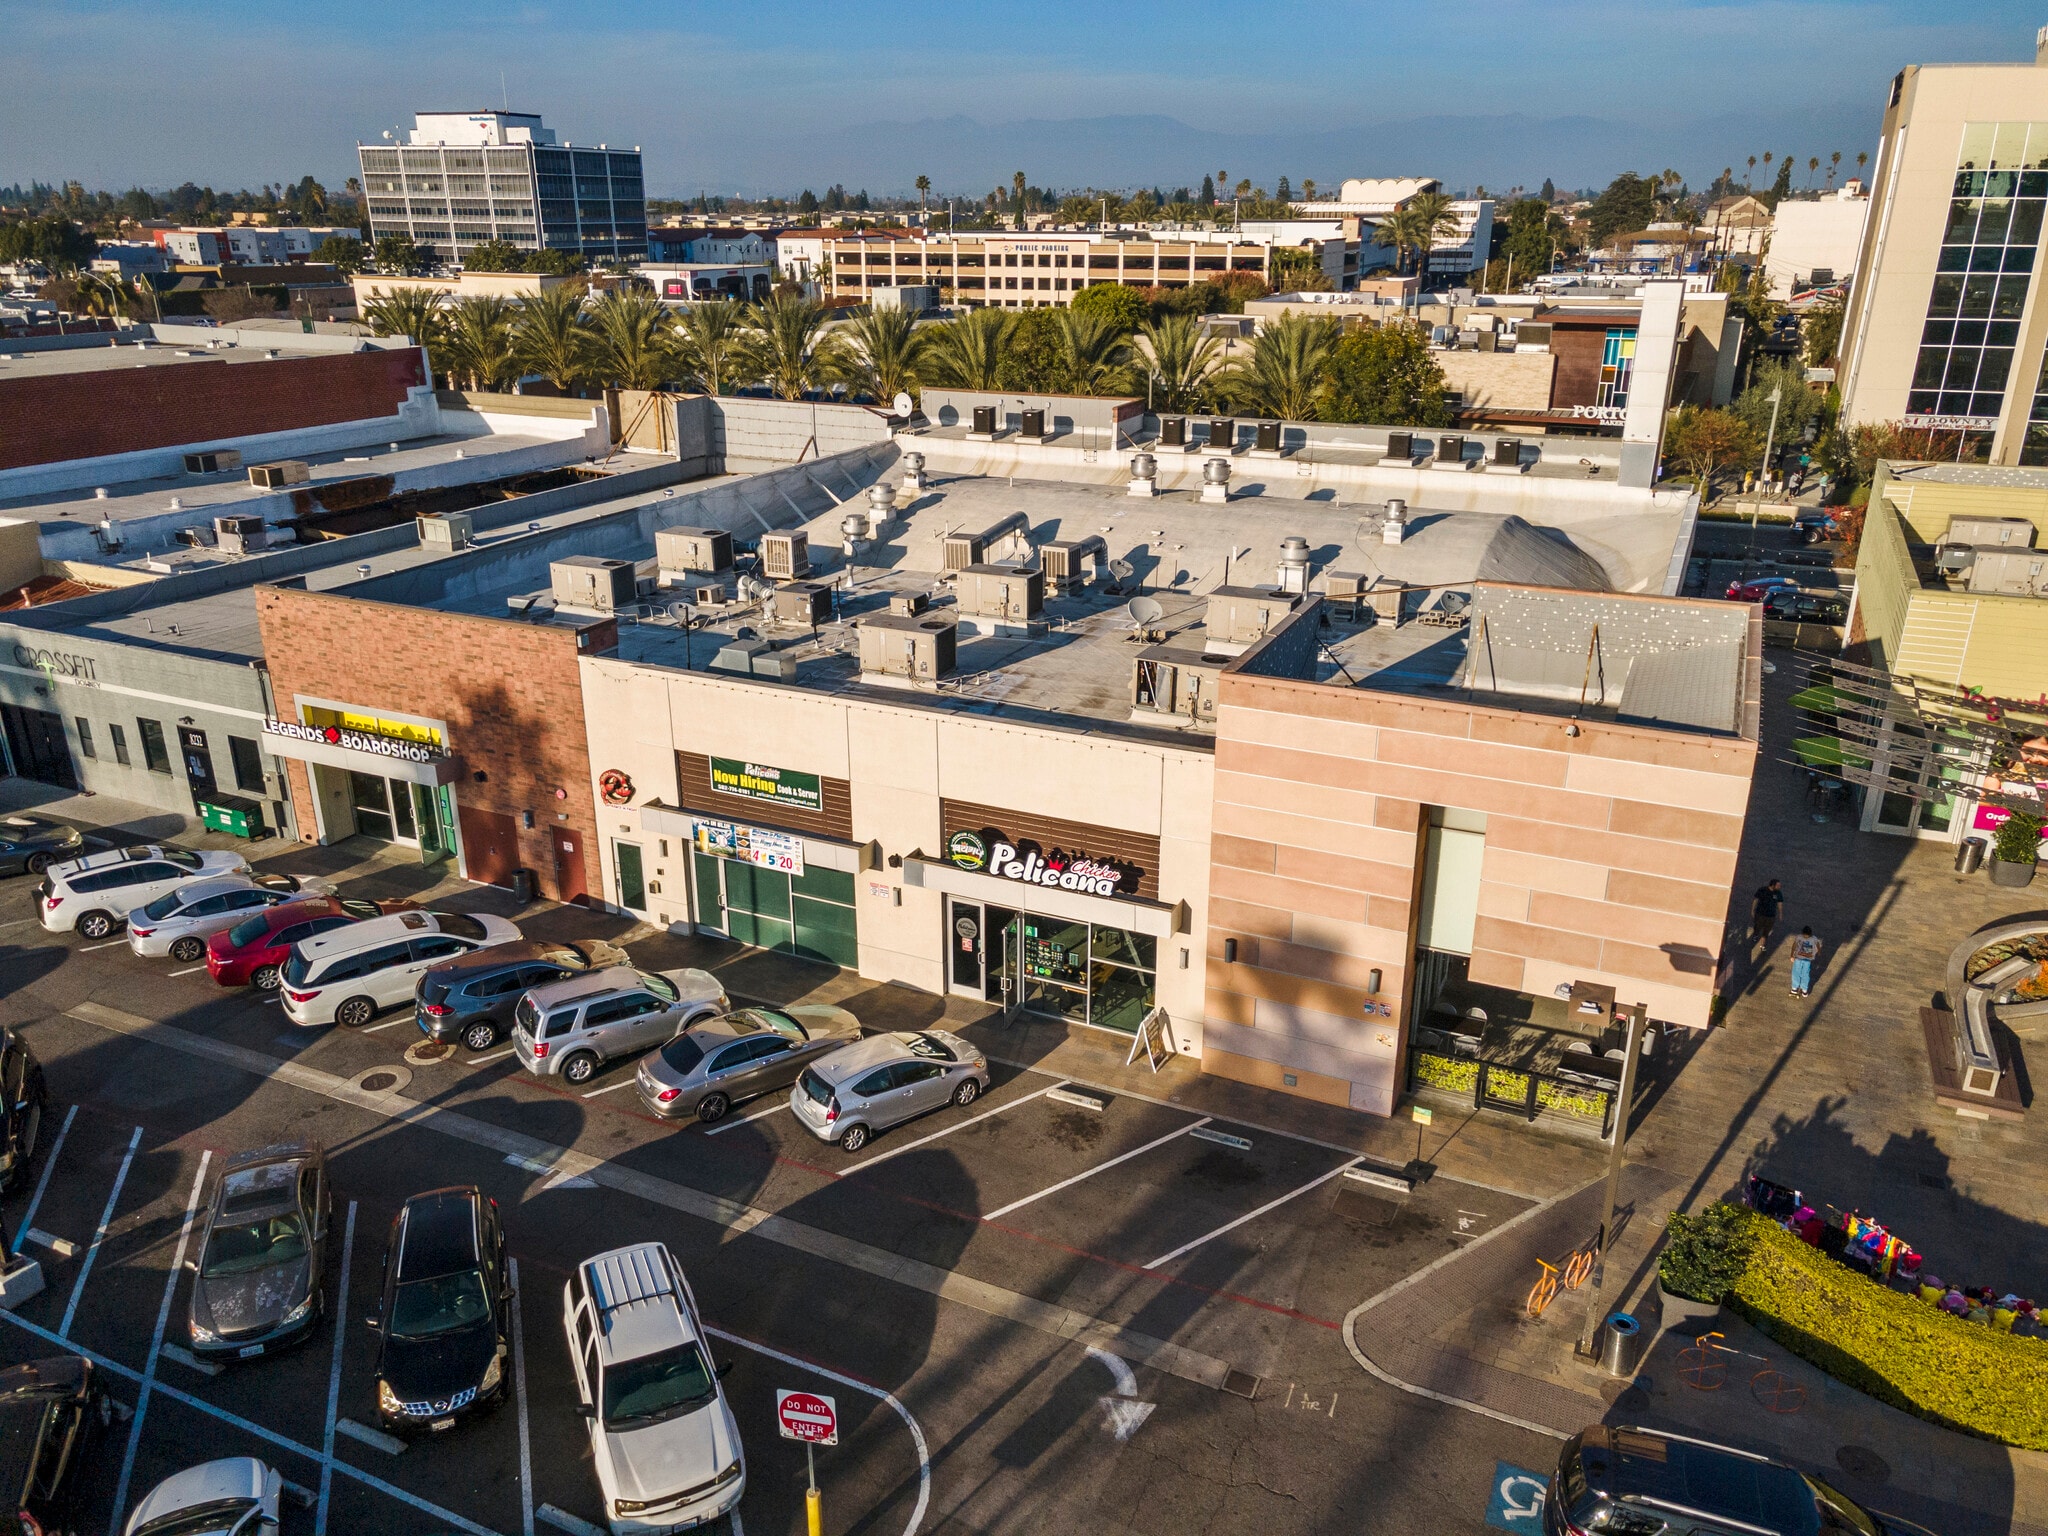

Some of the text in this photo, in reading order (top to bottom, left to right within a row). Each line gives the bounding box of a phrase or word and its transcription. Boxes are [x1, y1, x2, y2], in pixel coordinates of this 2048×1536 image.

[1926, 417, 1994, 425] DOWNEY
[13, 645, 96, 680] CROSSFIT
[262, 718, 431, 763] LEGENDS BOARDSHOP
[713, 769, 738, 786] Now
[740, 774, 776, 794] Hiring
[777, 784, 792, 797] Cook
[798, 788, 818, 800] Server
[1985, 812, 2011, 821] Orde
[989, 842, 1115, 897] Pelicana
[1070, 859, 1121, 882] Chicken
[787, 1400, 826, 1413] DO NOT
[792, 1421, 824, 1434] ENTER
